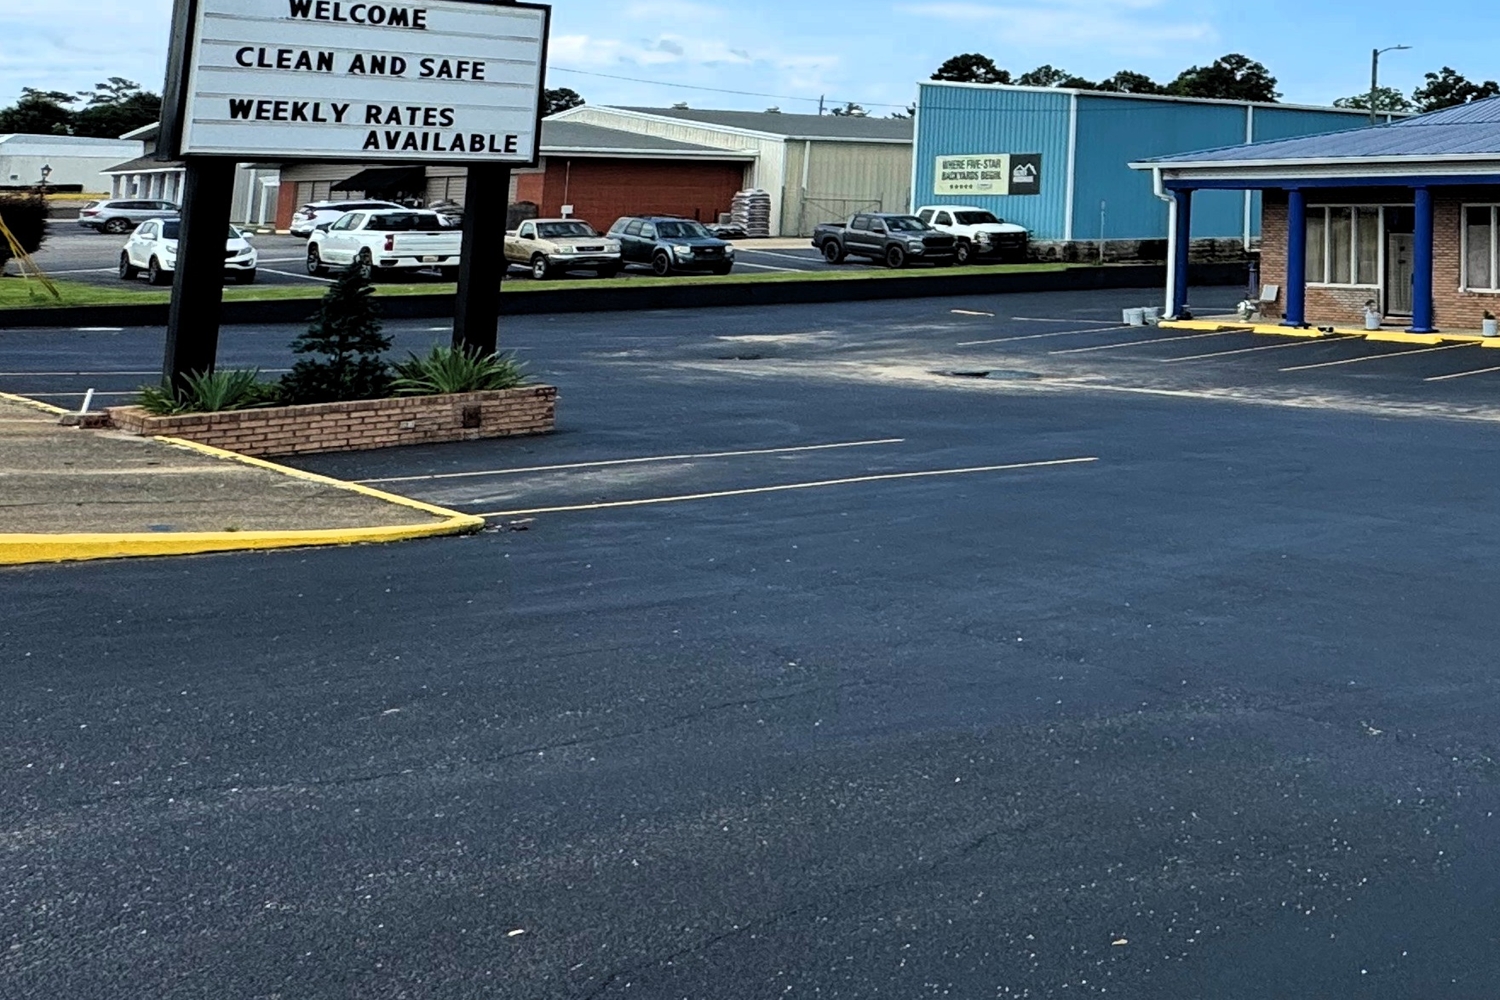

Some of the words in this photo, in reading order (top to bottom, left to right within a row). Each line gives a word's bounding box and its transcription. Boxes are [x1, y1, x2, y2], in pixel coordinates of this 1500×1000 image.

[235, 47, 334, 72] CLEAN
[348, 54, 407, 76] AND
[419, 58, 486, 81] SAFE
[229, 99, 350, 123] WEEKLY
[365, 106, 455, 127] RATES
[362, 131, 518, 153] AVAILABLE
[942, 160, 966, 170] WHERE
